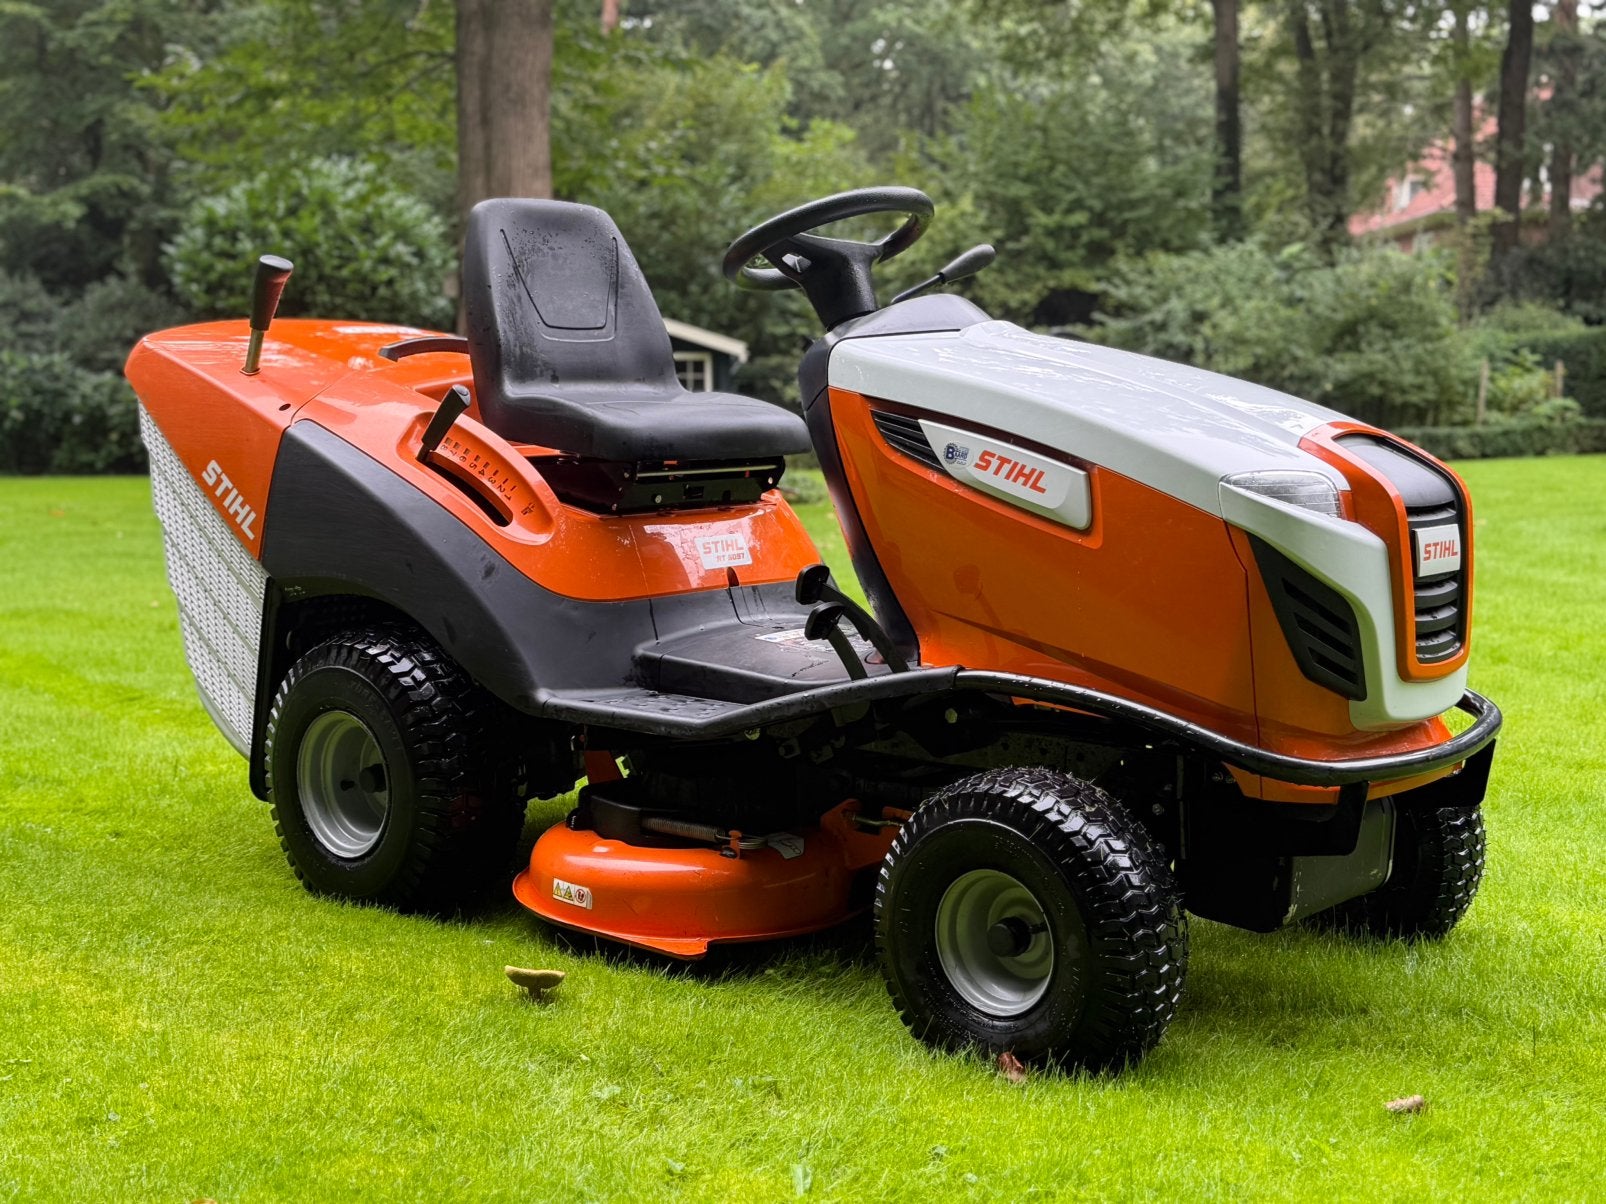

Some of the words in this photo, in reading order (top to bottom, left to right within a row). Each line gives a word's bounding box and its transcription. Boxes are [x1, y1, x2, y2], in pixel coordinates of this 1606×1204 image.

[469, 462, 477, 470] 5
[478, 468, 486, 476] 4
[496, 485, 506, 493] 2
[973, 450, 1047, 494] STIHL
[201, 459, 257, 541] STIHL
[703, 539, 744, 555] STIHL
[1423, 539, 1458, 562] STIHL
